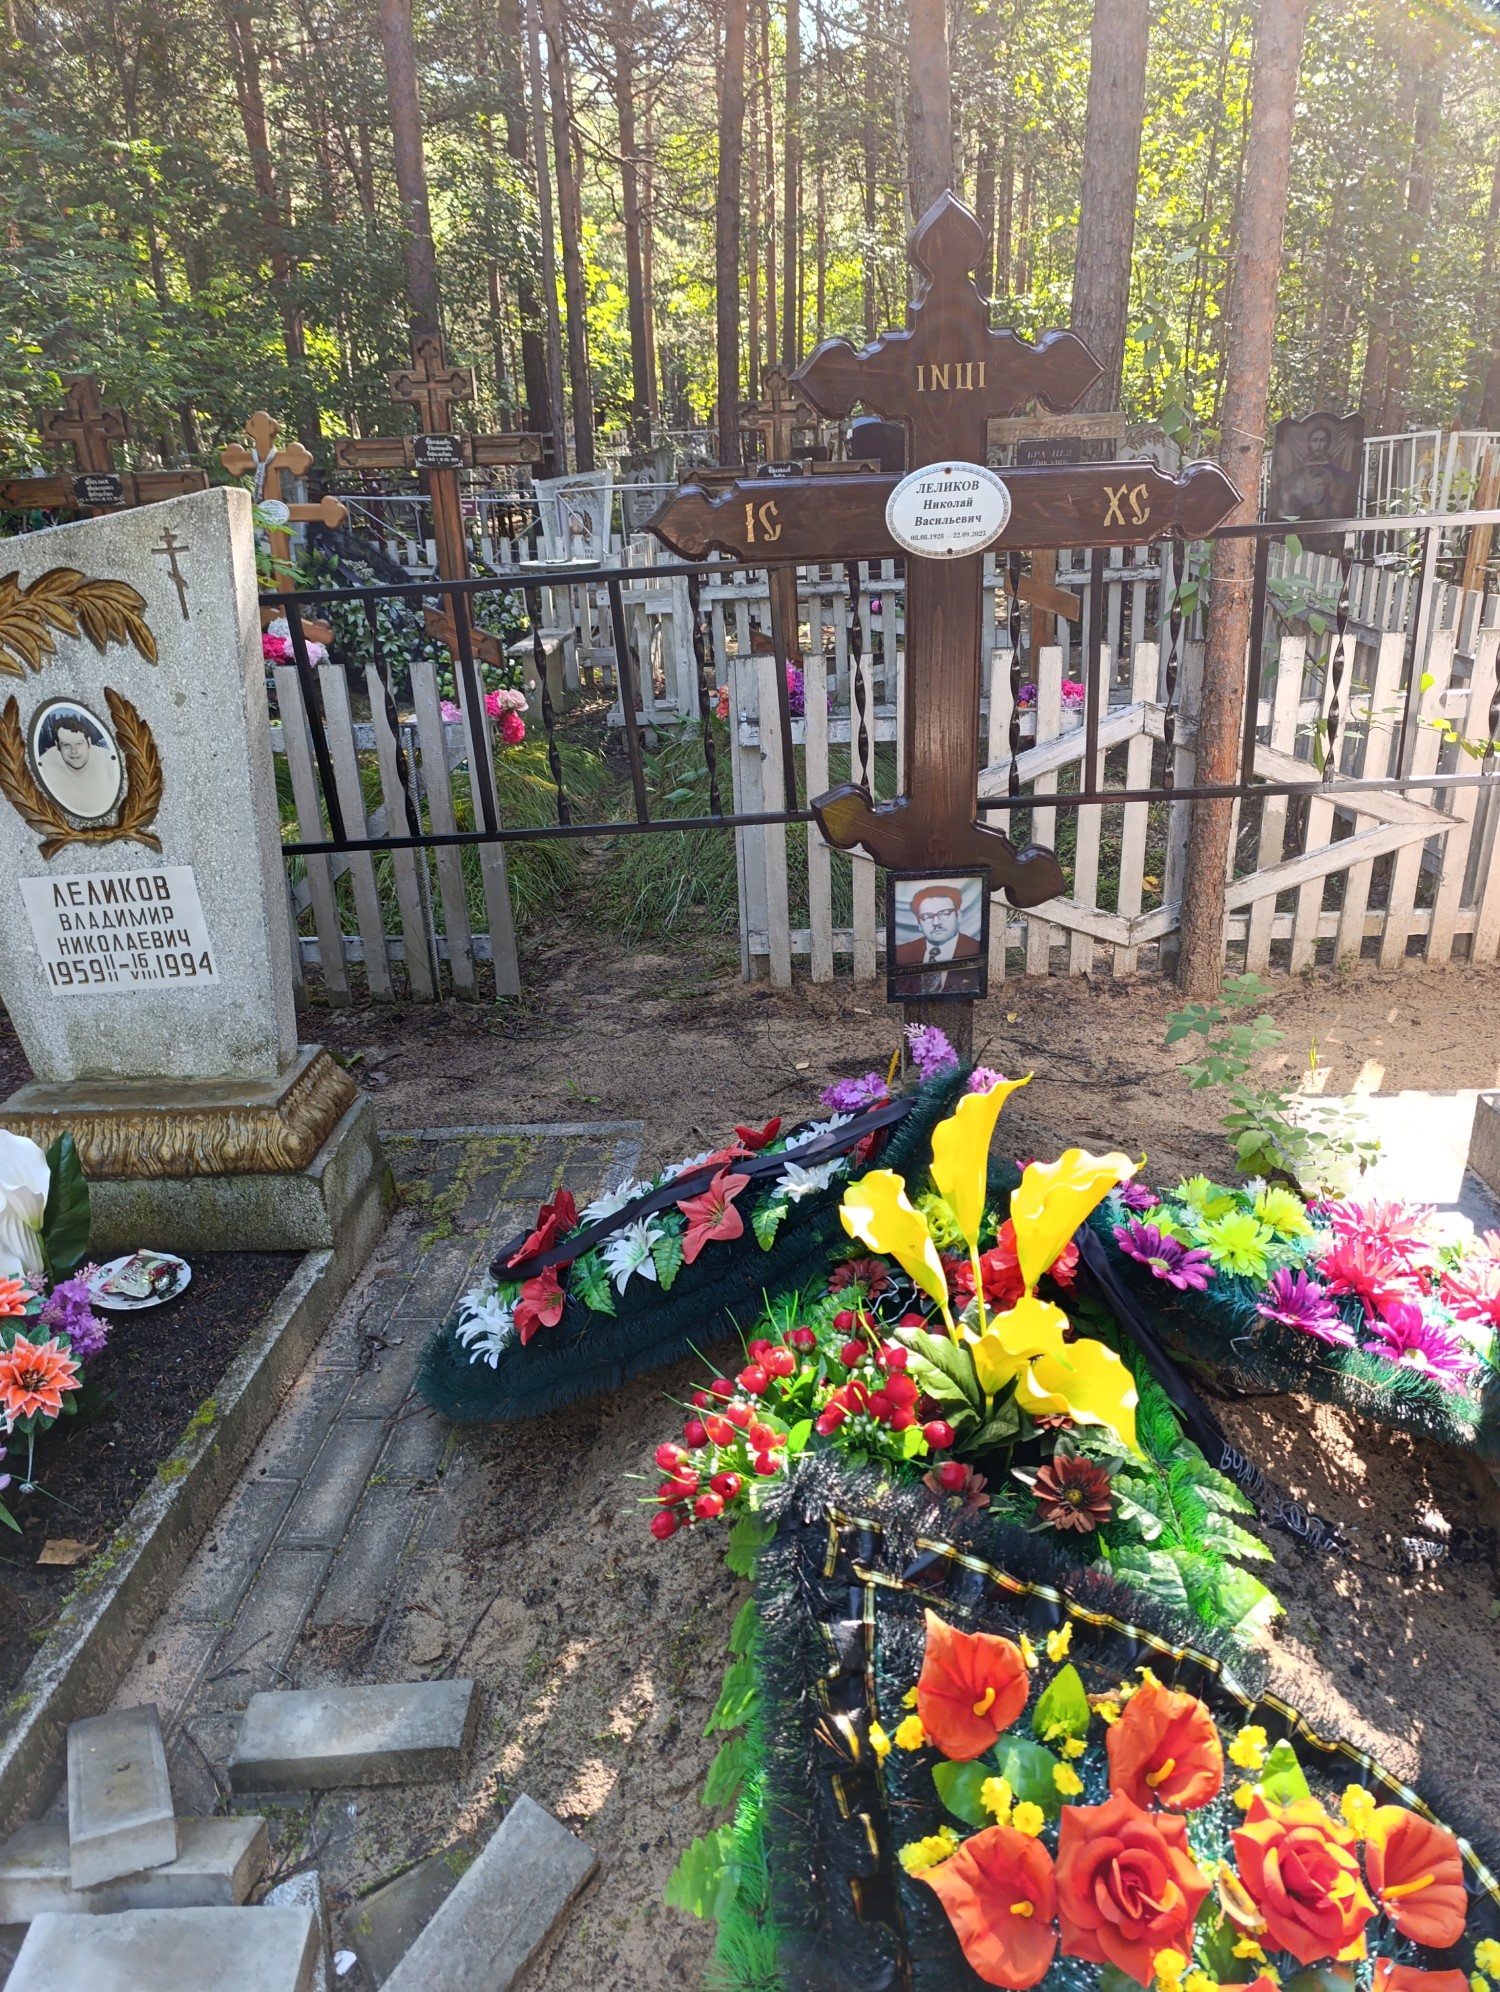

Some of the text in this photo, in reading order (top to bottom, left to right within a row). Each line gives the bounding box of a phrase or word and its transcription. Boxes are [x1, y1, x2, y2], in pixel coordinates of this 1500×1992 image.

[916, 480, 980, 494] ЛЕЛИКОВ
[923, 497, 973, 510] Николай
[914, 514, 982, 526] Васильевич
[52, 875, 171, 908] ЛЕЛИКОВ
[58, 905, 174, 931] ВЛАДИМИР
[57, 928, 191, 955] НИКОЛАЕВИЧ
[48, 958, 106, 986] 1959
